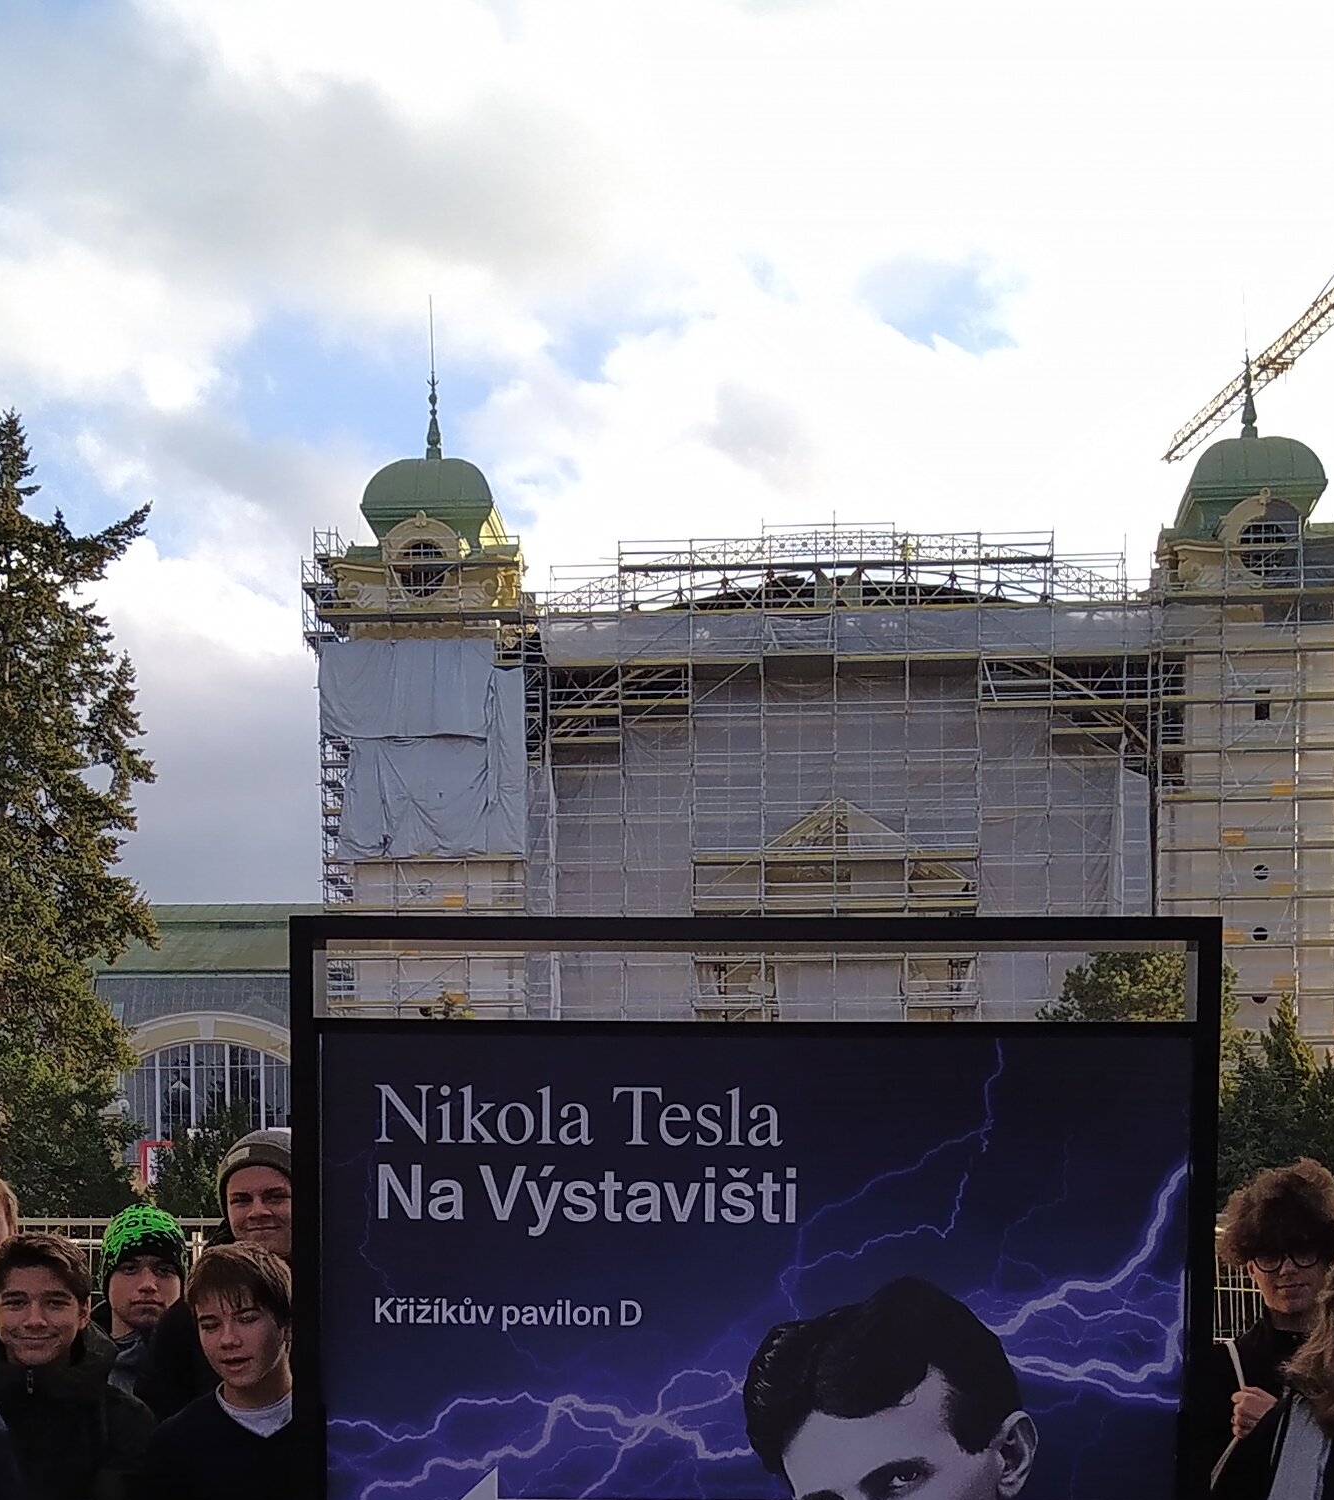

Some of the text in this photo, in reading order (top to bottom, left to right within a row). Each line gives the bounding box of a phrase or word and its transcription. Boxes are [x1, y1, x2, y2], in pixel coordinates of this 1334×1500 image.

[374, 1084, 783, 1147] Nikola Tesla
[377, 1163, 797, 1237] Na Výstavišti
[374, 1296, 642, 1332] Křižíkův pavilon D
